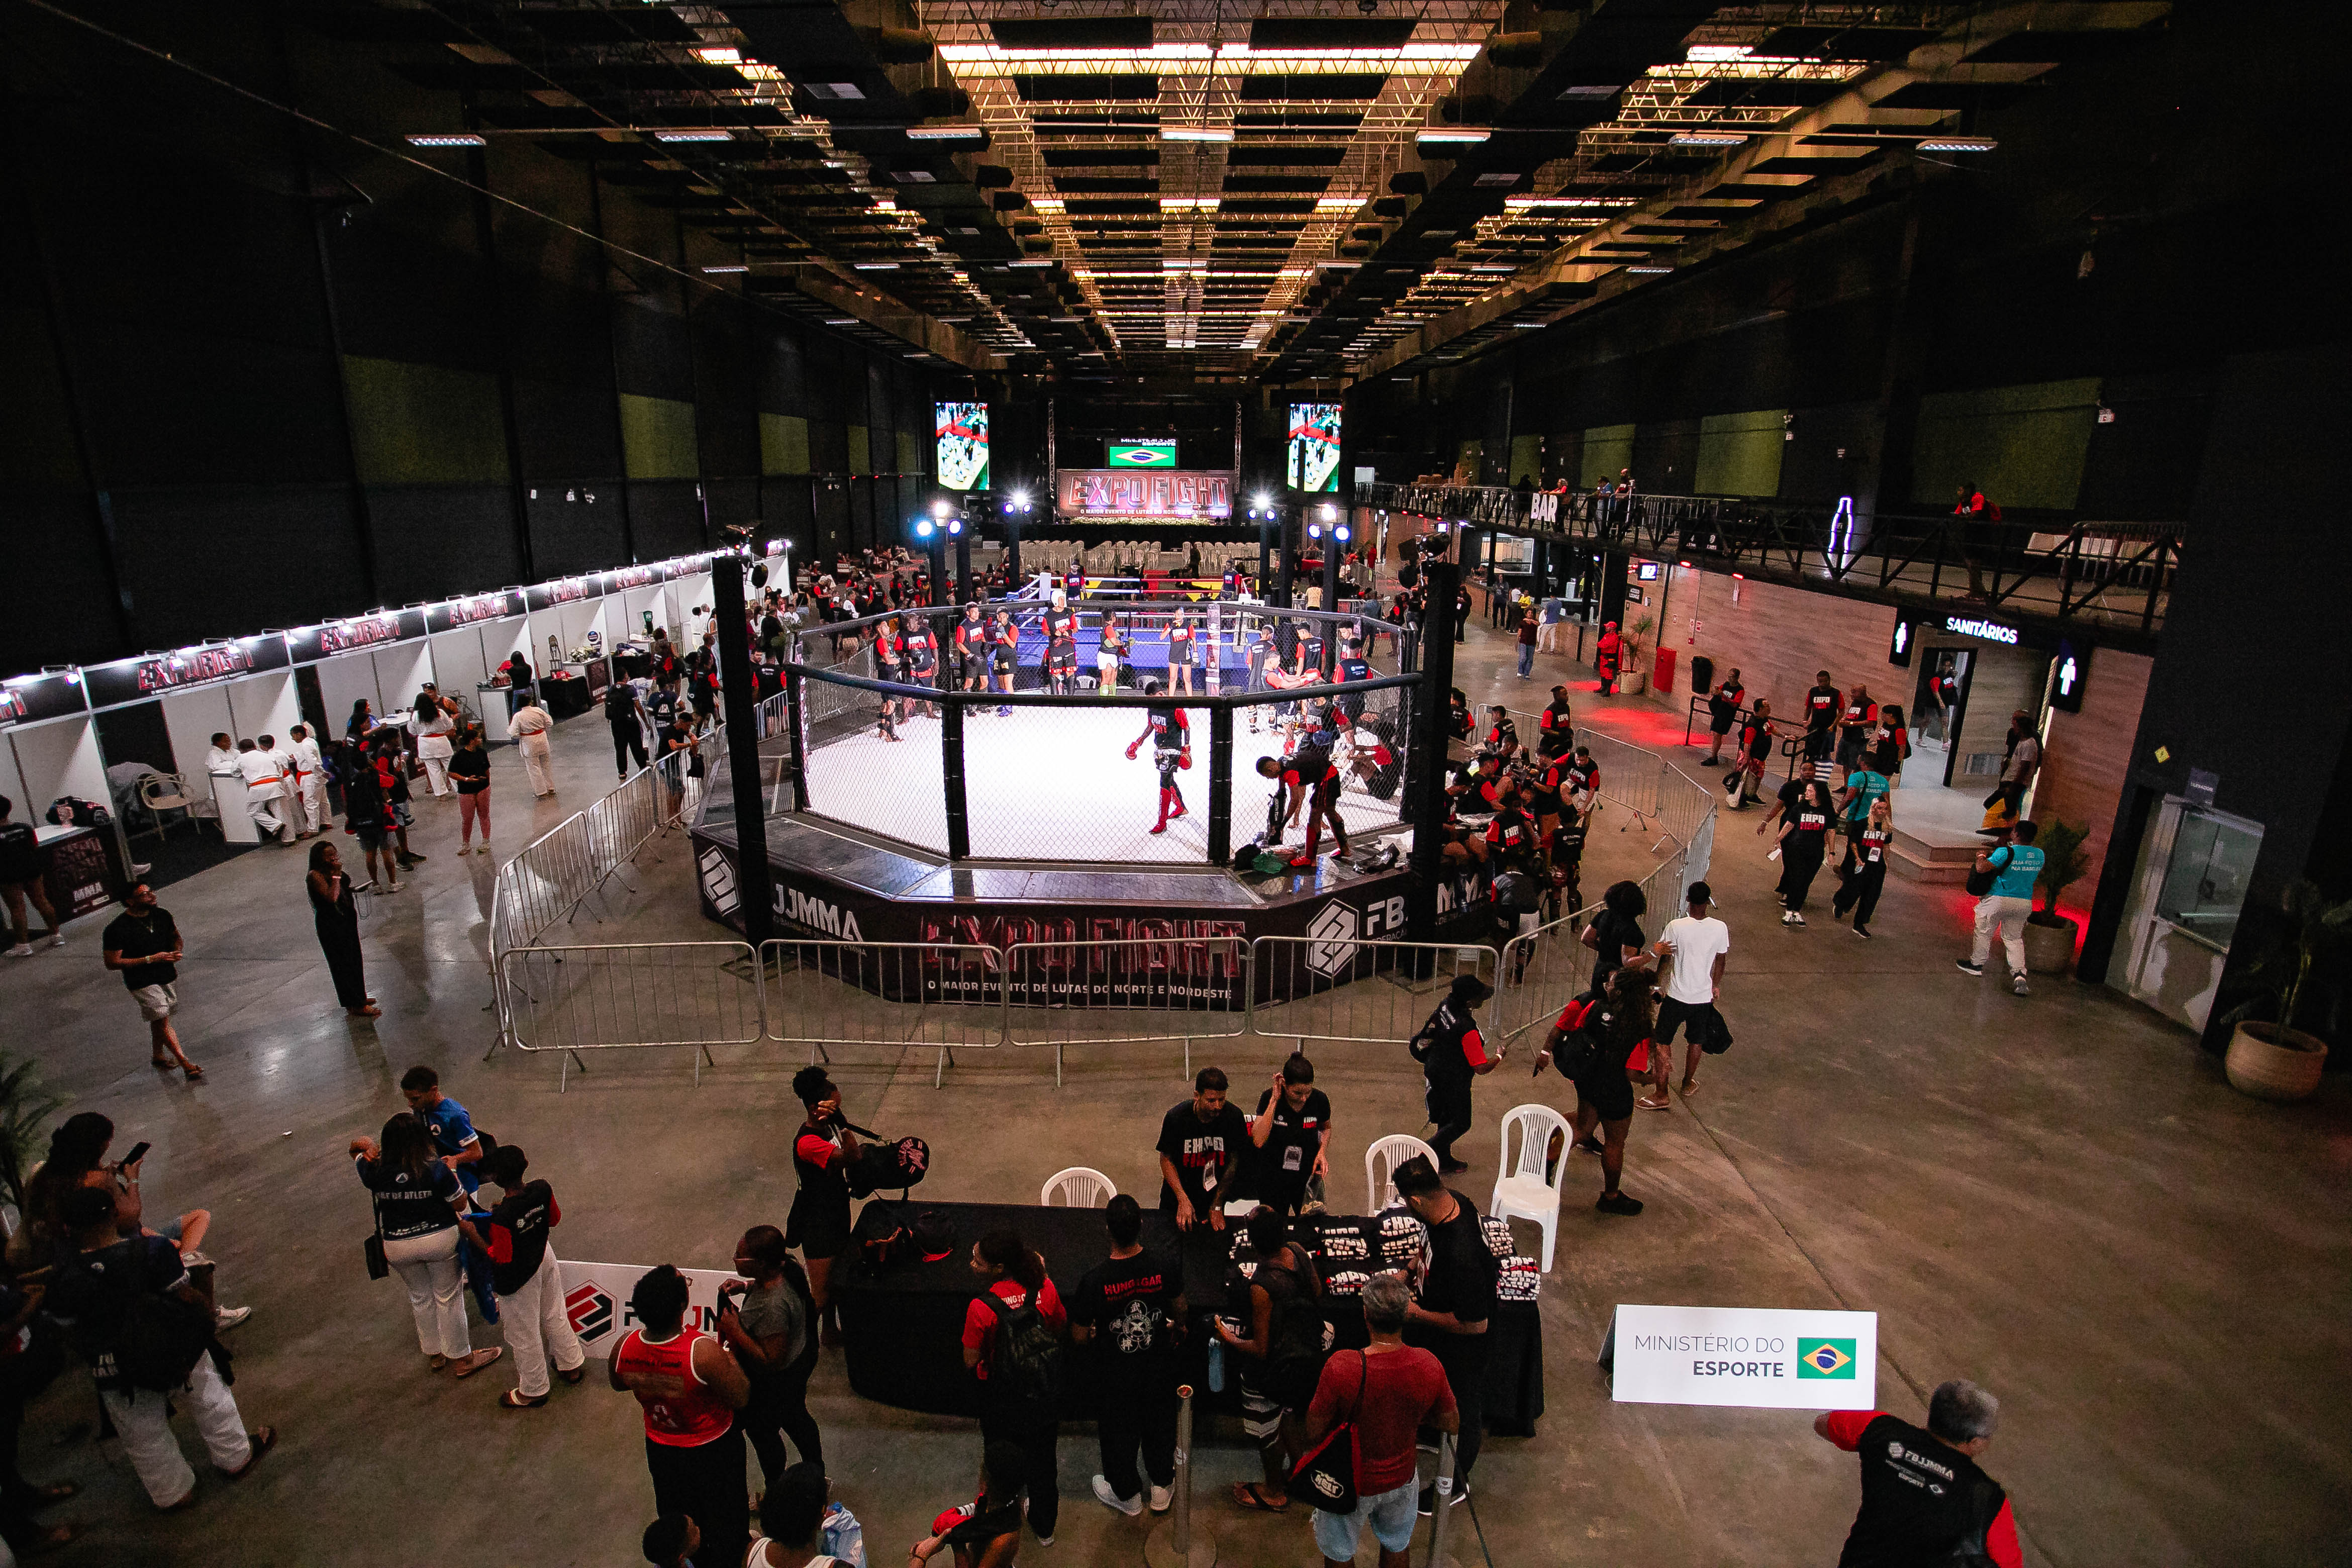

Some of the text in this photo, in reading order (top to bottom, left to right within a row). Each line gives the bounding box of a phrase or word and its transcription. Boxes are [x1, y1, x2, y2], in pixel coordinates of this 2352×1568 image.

[1069, 475, 1229, 508] EXPO FIGHT
[1531, 493, 1557, 522] BAR
[1946, 617, 2018, 645] SANITÁRIOS
[1086, 918, 1245, 977] FIGHT
[928, 981, 936, 990] O
[940, 981, 978, 991] MAIOR
[1033, 983, 1047, 993] DE
[1052, 984, 1089, 994] LUTAS
[1114, 985, 1154, 995] NORTE
[1158, 986, 1165, 995] E
[1169, 986, 1232, 999] NORDESTE
[1104, 1279, 1135, 1295] HUNG
[1141, 1275, 1162, 1287] GAR
[1634, 1332, 1784, 1353] MINISTÉRIO DO
[1693, 1360, 1784, 1378] ESPORTE
